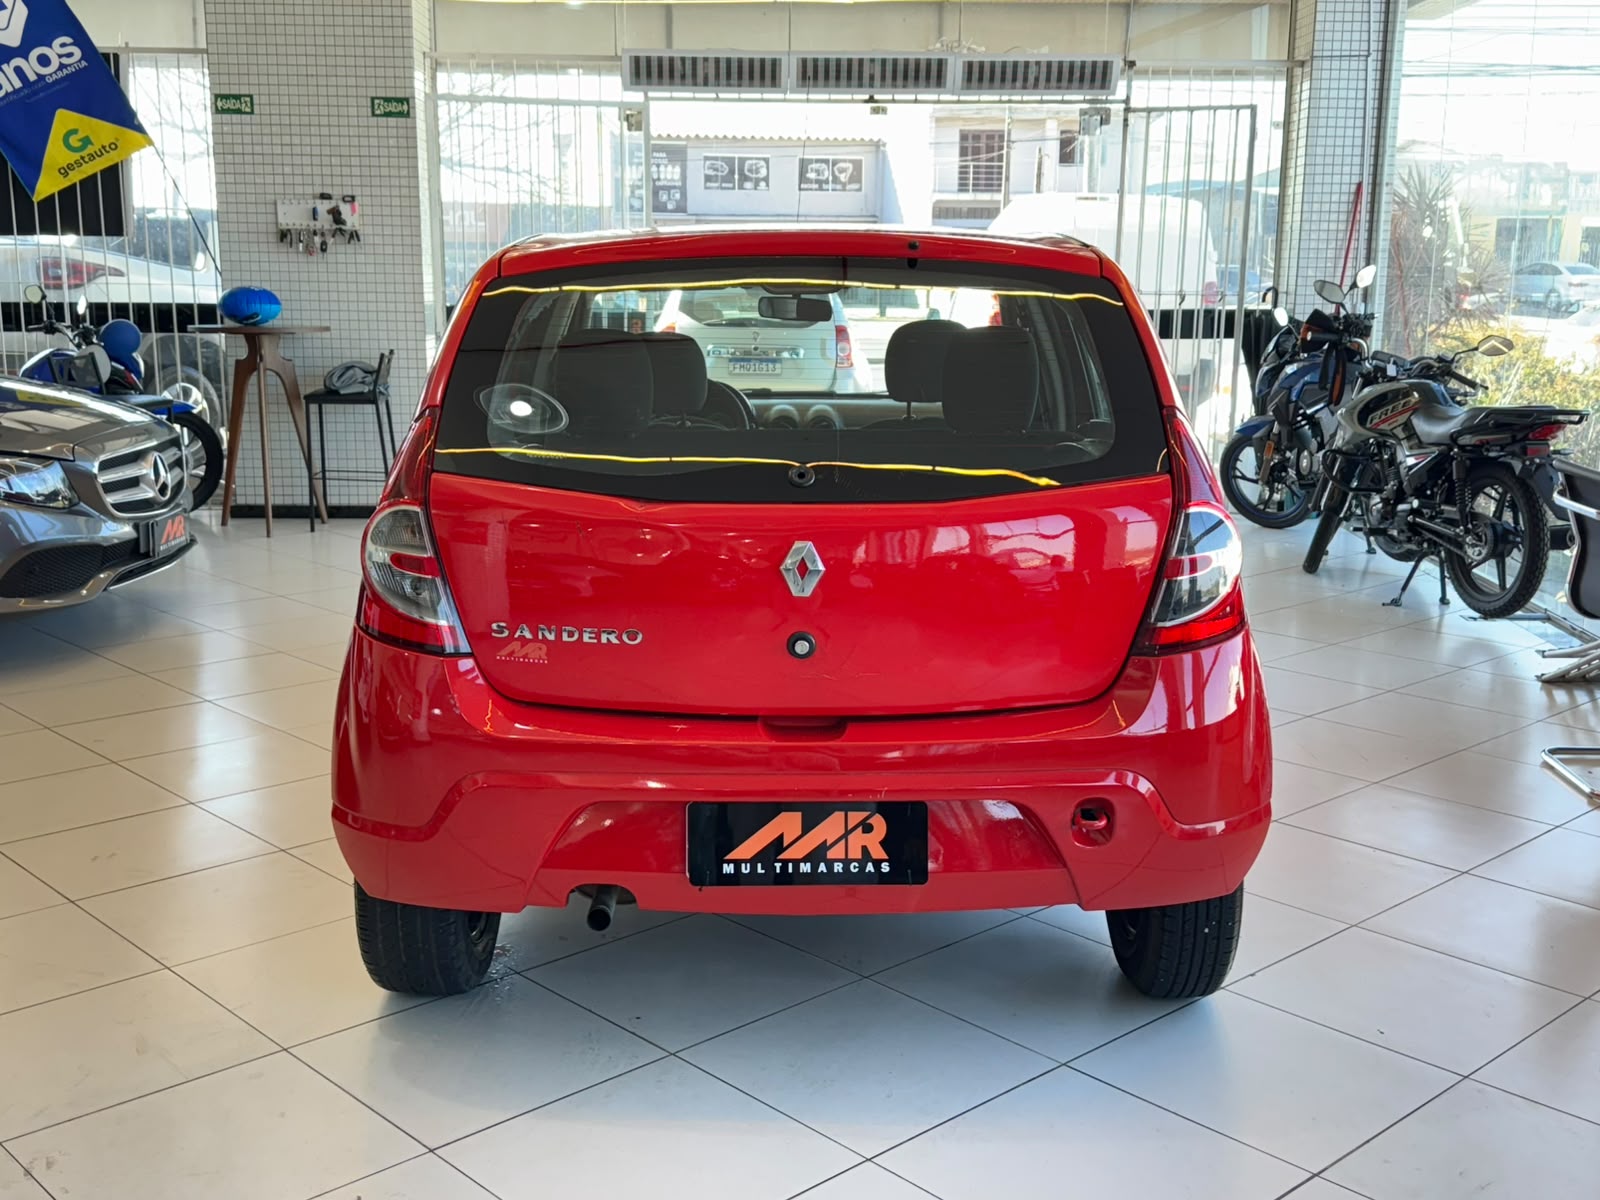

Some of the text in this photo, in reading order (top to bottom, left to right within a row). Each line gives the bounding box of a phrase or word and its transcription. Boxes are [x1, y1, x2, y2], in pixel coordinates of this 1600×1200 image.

[45, 60, 88, 83] GARANTIA
[57, 141, 119, 178] gestauto
[491, 622, 643, 645] SANDERO
[722, 862, 891, 874] MULTIMARCAS
